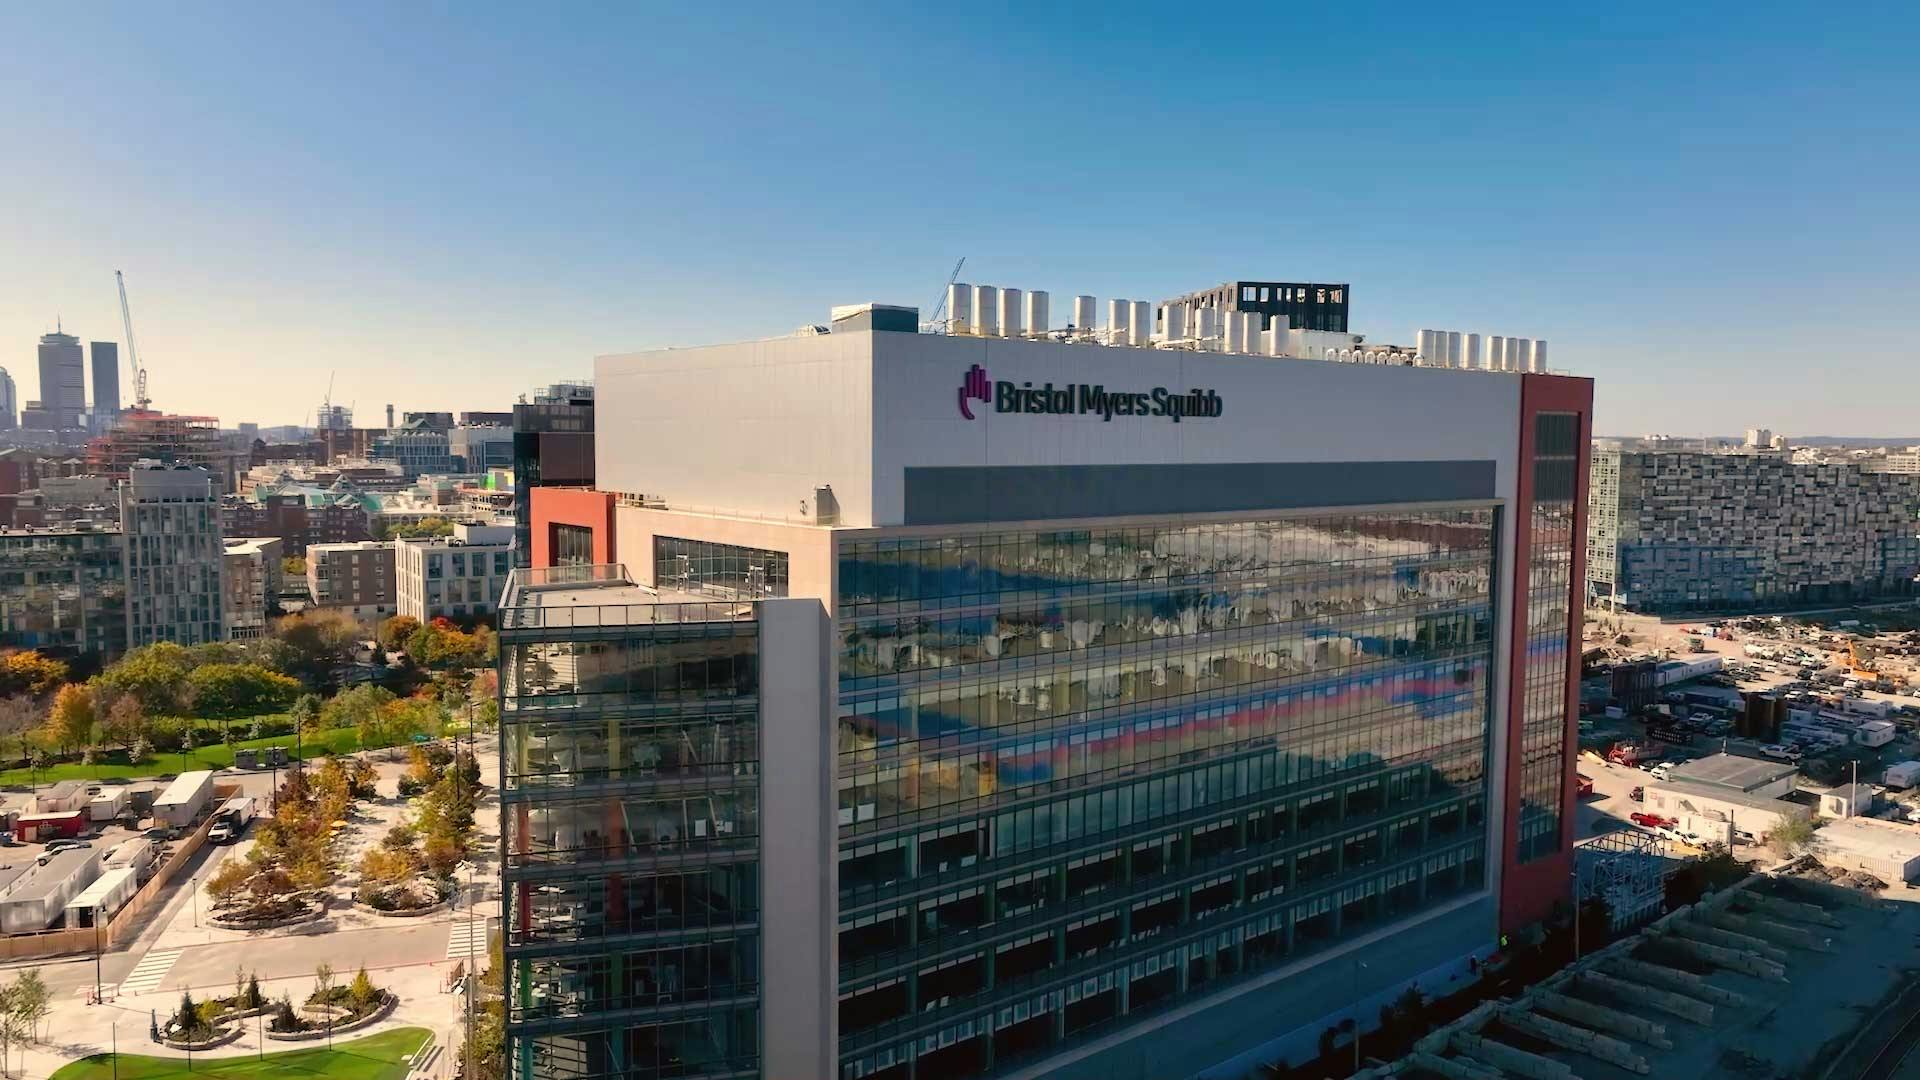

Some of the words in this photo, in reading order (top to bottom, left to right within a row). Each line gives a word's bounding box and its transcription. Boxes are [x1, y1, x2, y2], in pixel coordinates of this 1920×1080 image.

[996, 381, 1076, 415] Bristol
[1080, 384, 1150, 422] Myers
[1151, 387, 1223, 423] Squibb
